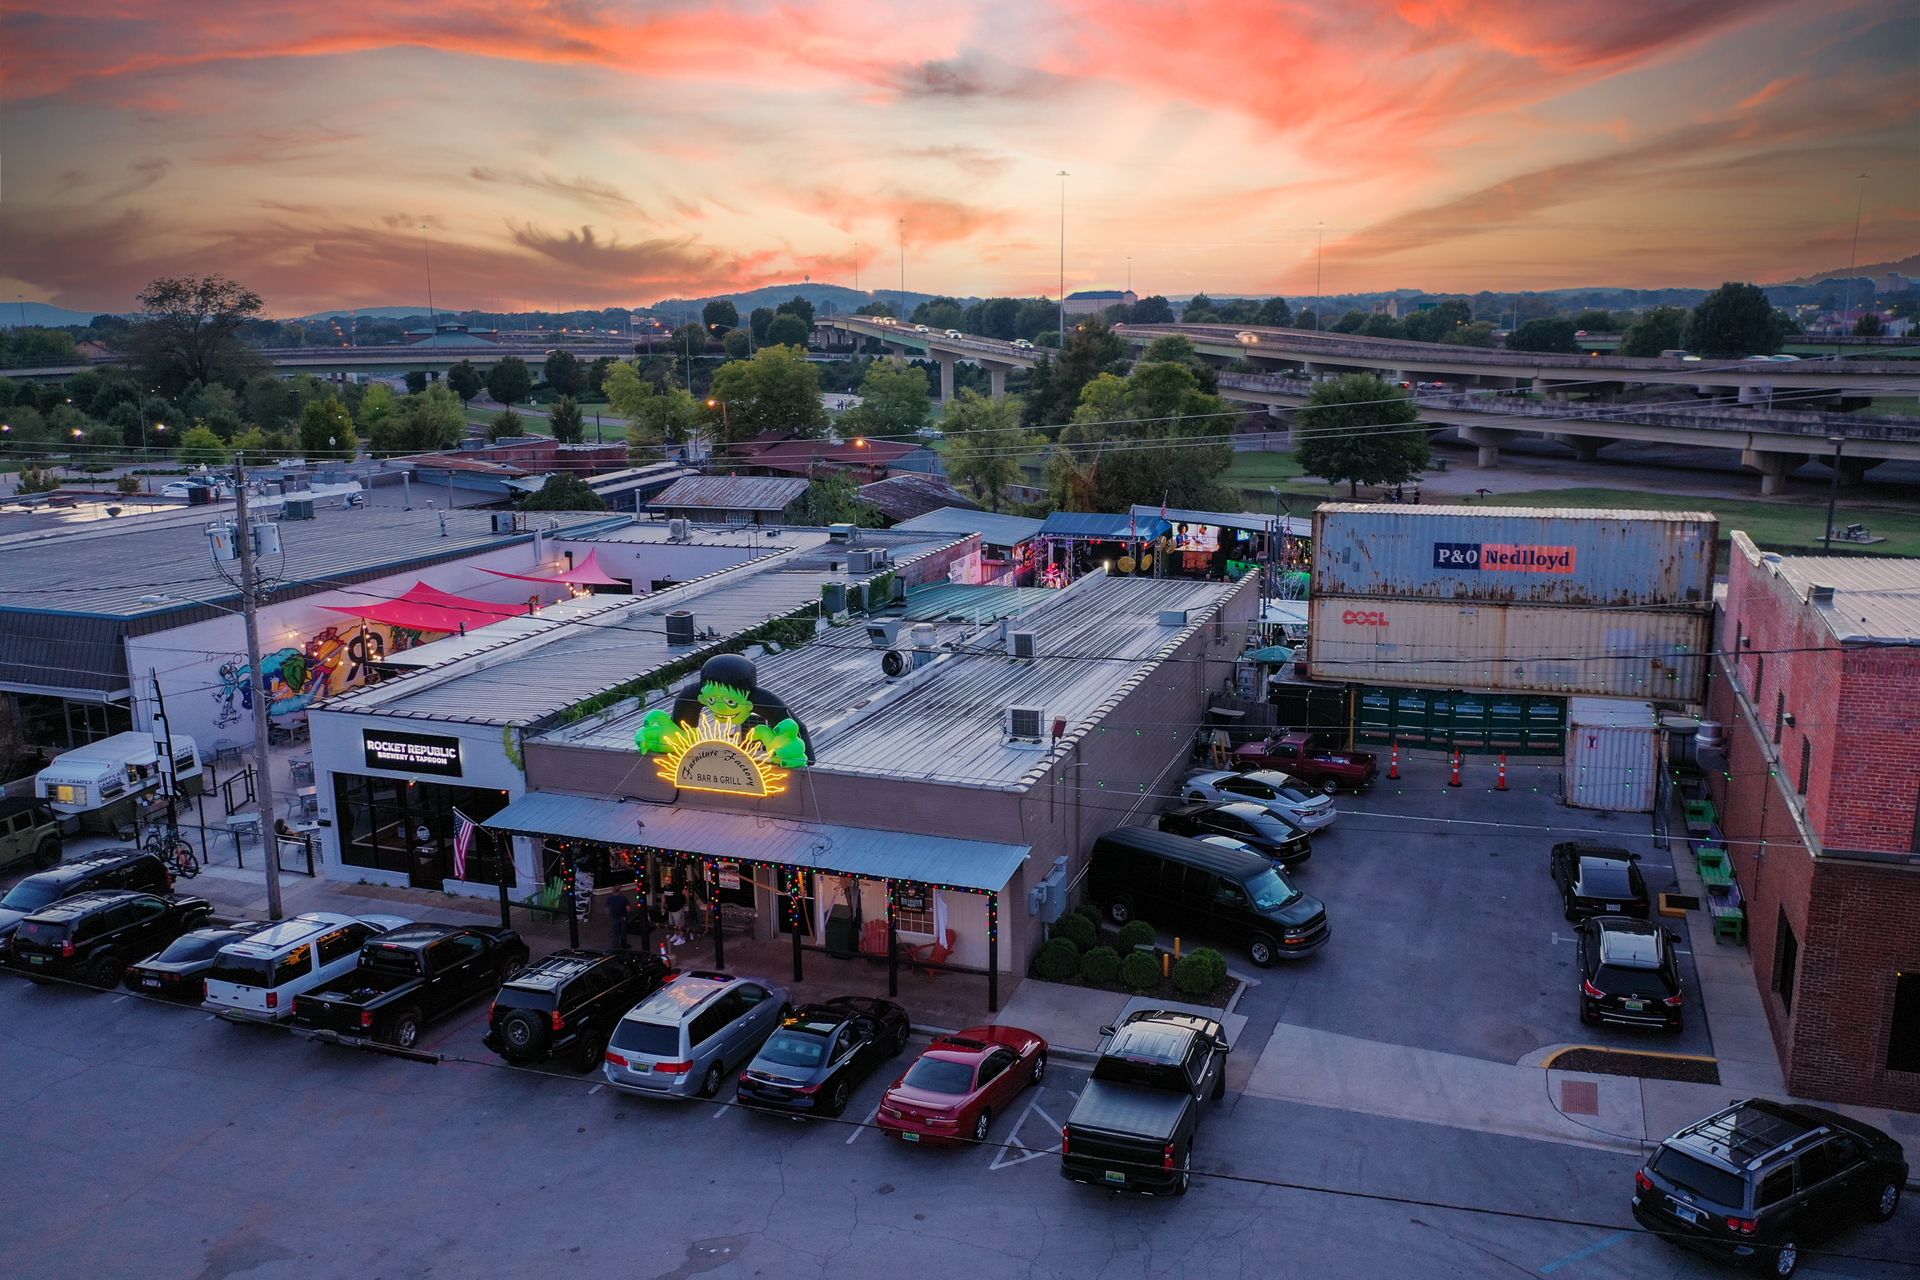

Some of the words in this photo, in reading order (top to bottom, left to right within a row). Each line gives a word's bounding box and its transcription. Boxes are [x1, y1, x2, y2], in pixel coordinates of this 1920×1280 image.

[1438, 549, 1478, 564] P&O
[1486, 549, 1569, 570] Nedlloyd
[366, 740, 407, 753] ROCKET
[407, 744, 456, 758] REPUBLIC
[377, 752, 408, 761] BREWERY
[416, 755, 447, 765] TAPROOM
[682, 750, 718, 780] Furniture
[724, 750, 754, 787] Factory
[697, 774, 712, 783] BAR
[720, 776, 741, 785] GRILL
